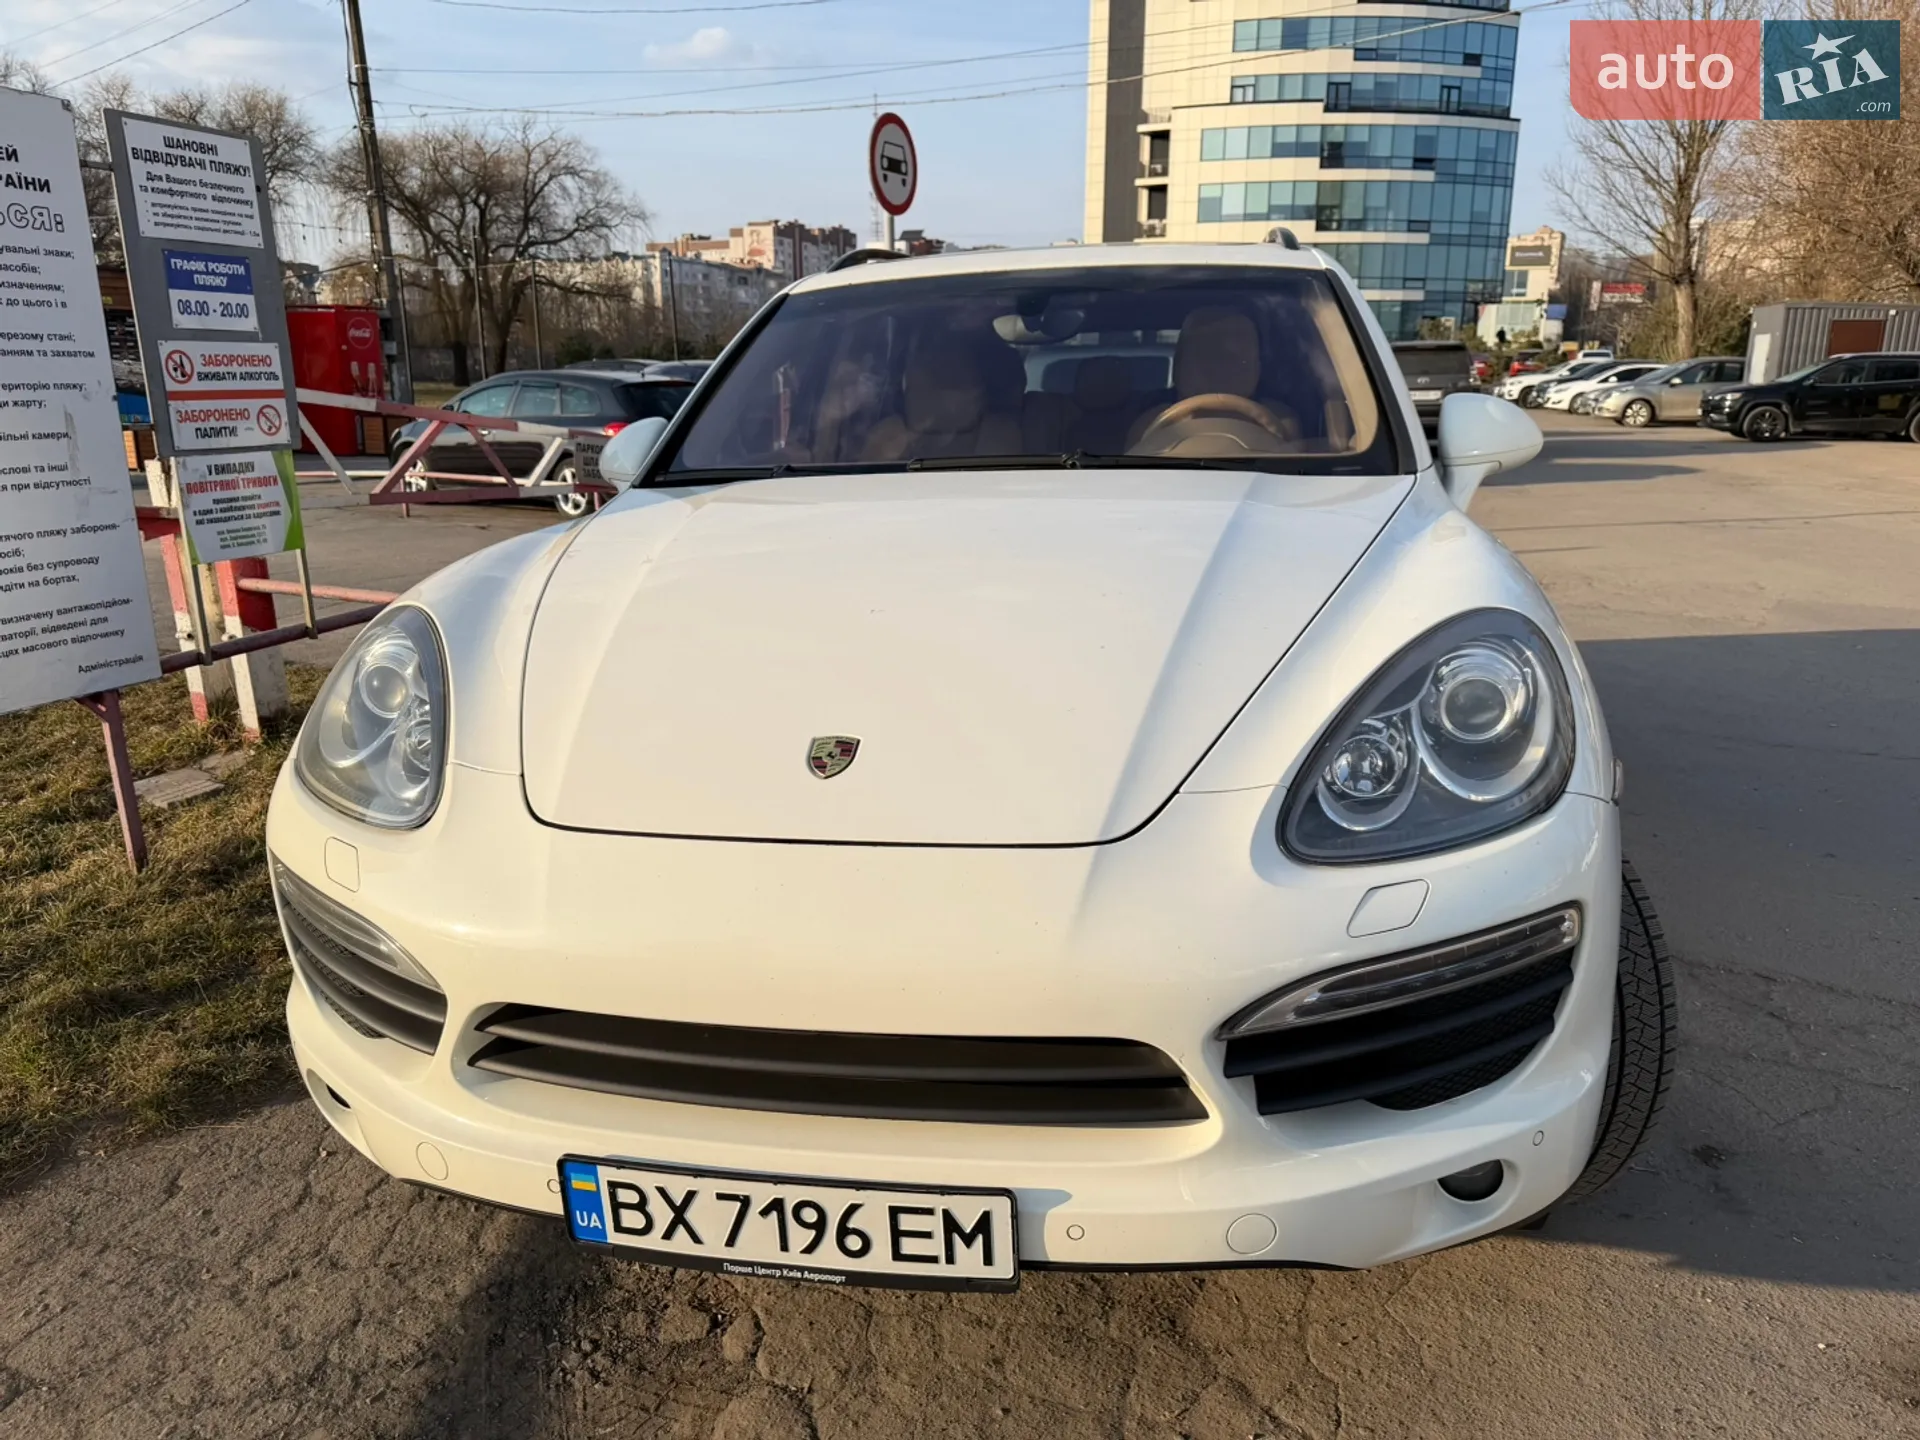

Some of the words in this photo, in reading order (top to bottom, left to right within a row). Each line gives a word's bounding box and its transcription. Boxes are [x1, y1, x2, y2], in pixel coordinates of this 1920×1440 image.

[163, 135, 218, 156] ШАНОВНІ
[131, 147, 207, 171] ВІДВІДУВАЧІ
[208, 160, 252, 178] ПЛЯЖУ!
[0, 171, 51, 193] АЇНИ
[43, 248, 75, 259] знаки;
[170, 258, 207, 272] ГРАФІК
[207, 262, 246, 275] РОБОТИ
[193, 274, 228, 287] ПЛЯЖУ
[22, 299, 53, 308] цього
[177, 299, 210, 316] 08.00
[219, 301, 250, 318] 20.00
[0, 348, 34, 357] анням
[200, 353, 273, 368] ЗАБОРОНЕНО
[196, 371, 237, 381] ВЖИВАТИ
[238, 371, 280, 382] АЛКОГОЛЬ
[1, 381, 51, 392] ериторію
[176, 408, 251, 424] ЗАБОРОНЕНО
[194, 426, 238, 439] ПАЛИТИ!
[206, 464, 212, 476] У
[213, 461, 255, 475] ВИПАДКУ
[11, 483, 30, 494] при
[185, 477, 241, 494] ПОВІТРЯНОЇ
[241, 475, 279, 489] ТРИВОГИ
[36, 528, 68, 538] пляжу
[26, 562, 44, 572] без
[46, 556, 100, 570] супроводу
[28, 579, 40, 588] на
[0, 627, 39, 642] ваторії,
[90, 616, 109, 627] для
[0, 648, 19, 658] цях
[22, 638, 69, 654] масового
[78, 653, 144, 673] Адміністрація
[576, 1210, 602, 1229] UA
[714, 1191, 873, 1259] 7196
[723, 1262, 752, 1274] Порше
[754, 1265, 782, 1277] Центр
[783, 1268, 802, 1278] Київ
[803, 1271, 847, 1283] Аеропорт
